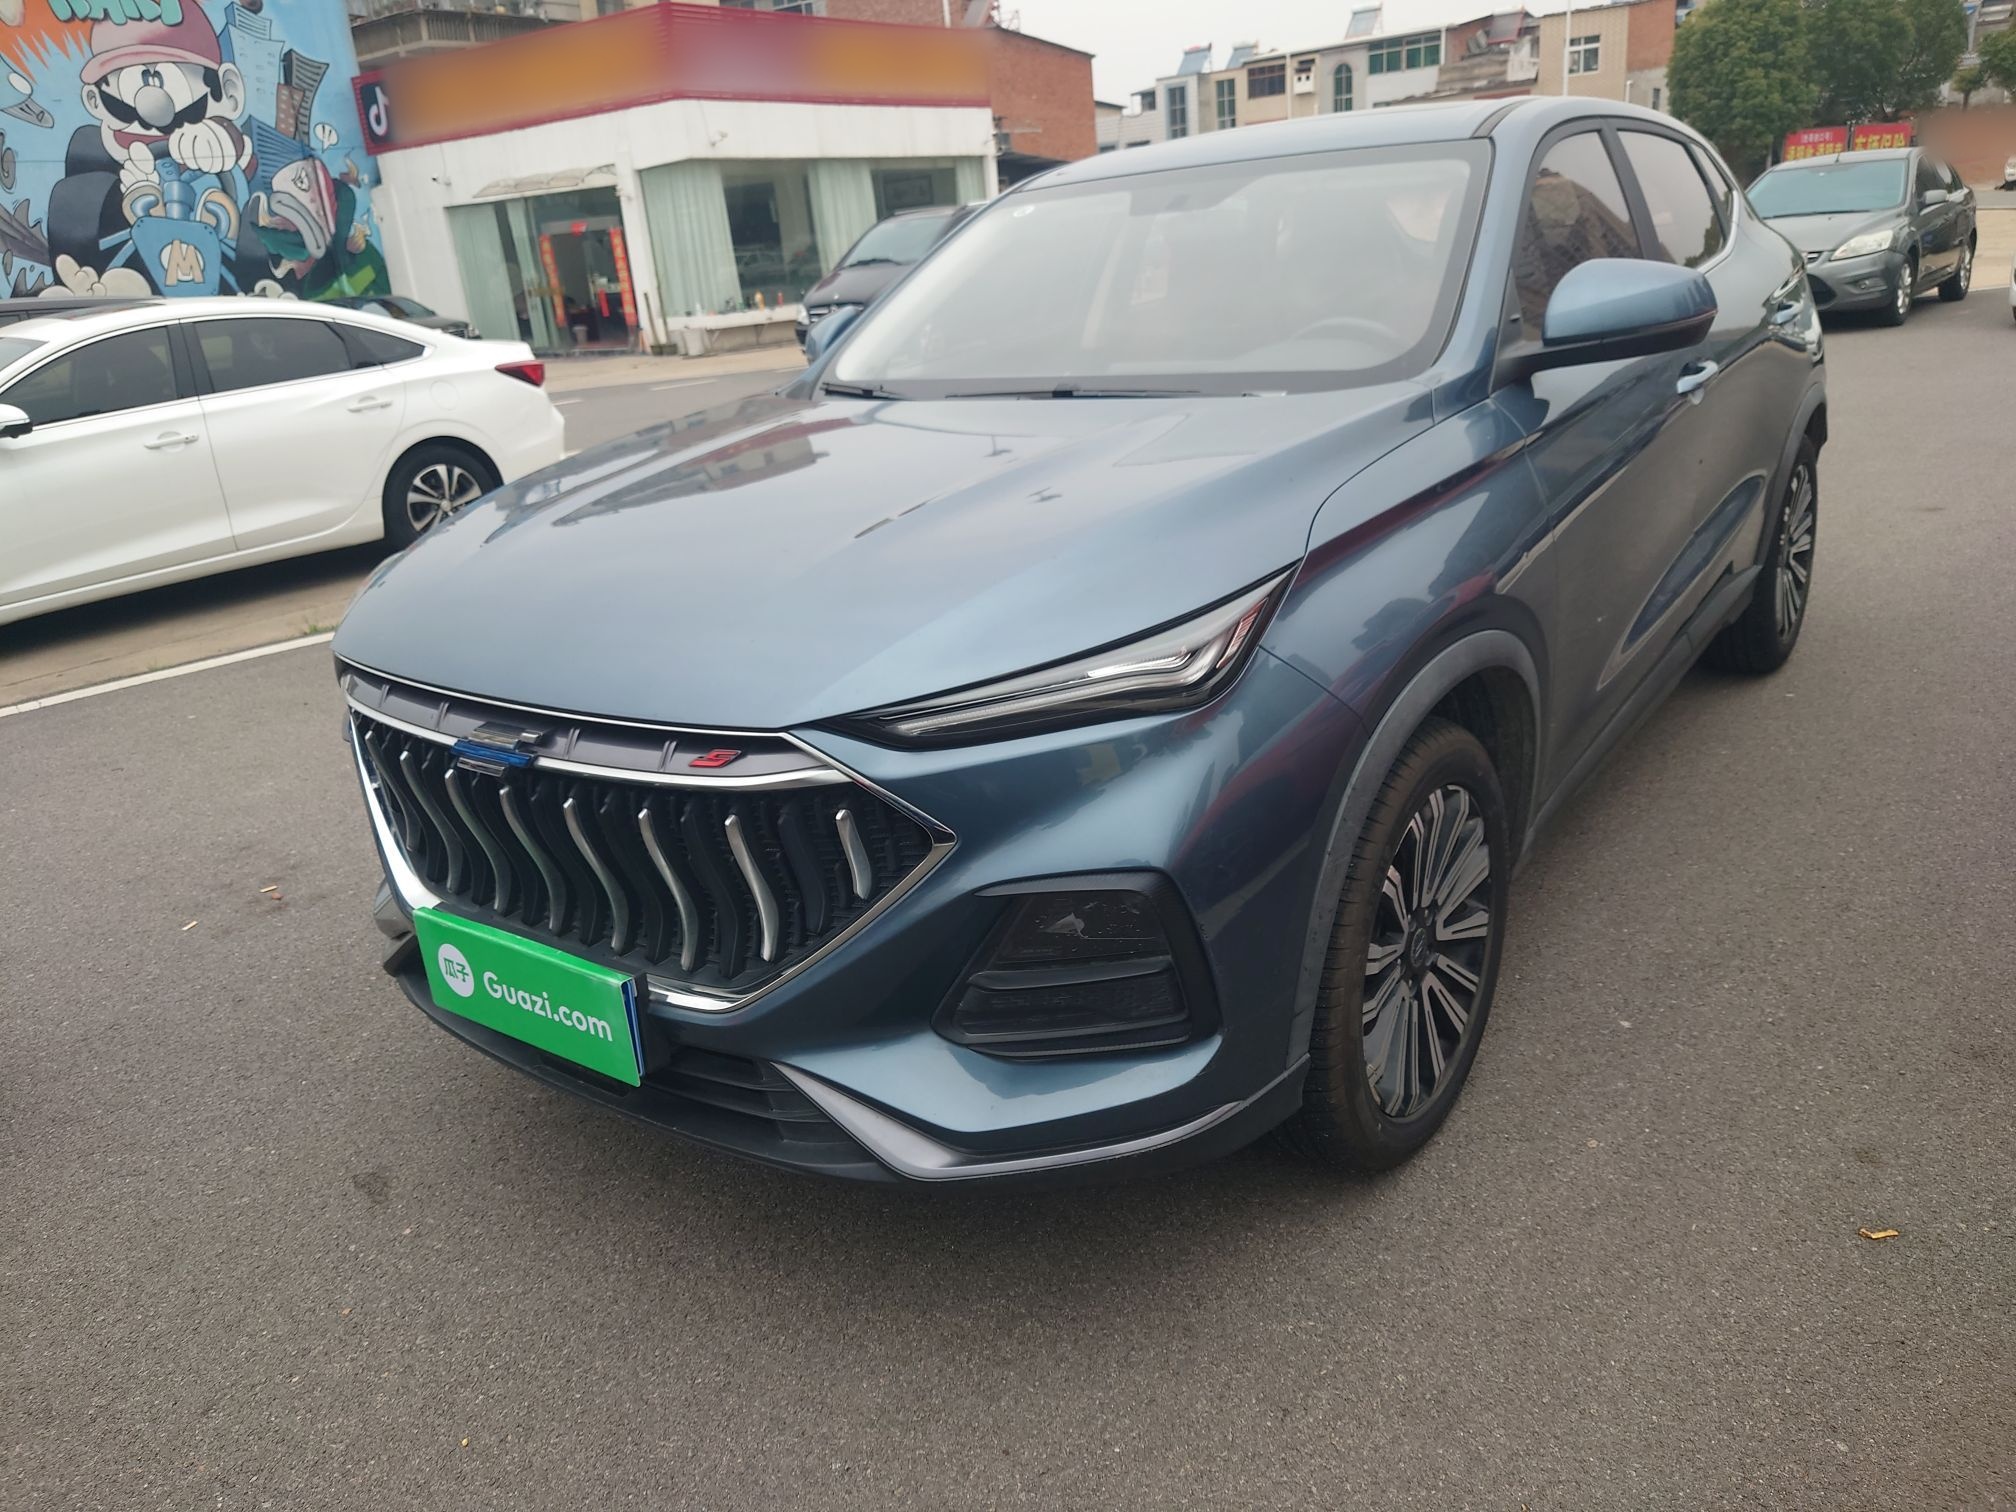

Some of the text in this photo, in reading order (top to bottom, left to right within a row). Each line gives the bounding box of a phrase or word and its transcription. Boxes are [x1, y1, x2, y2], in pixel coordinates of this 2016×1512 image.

[165, 239, 205, 287] M
[443, 957, 470, 983] 瓜子
[483, 971, 613, 1042] Guazi.com
